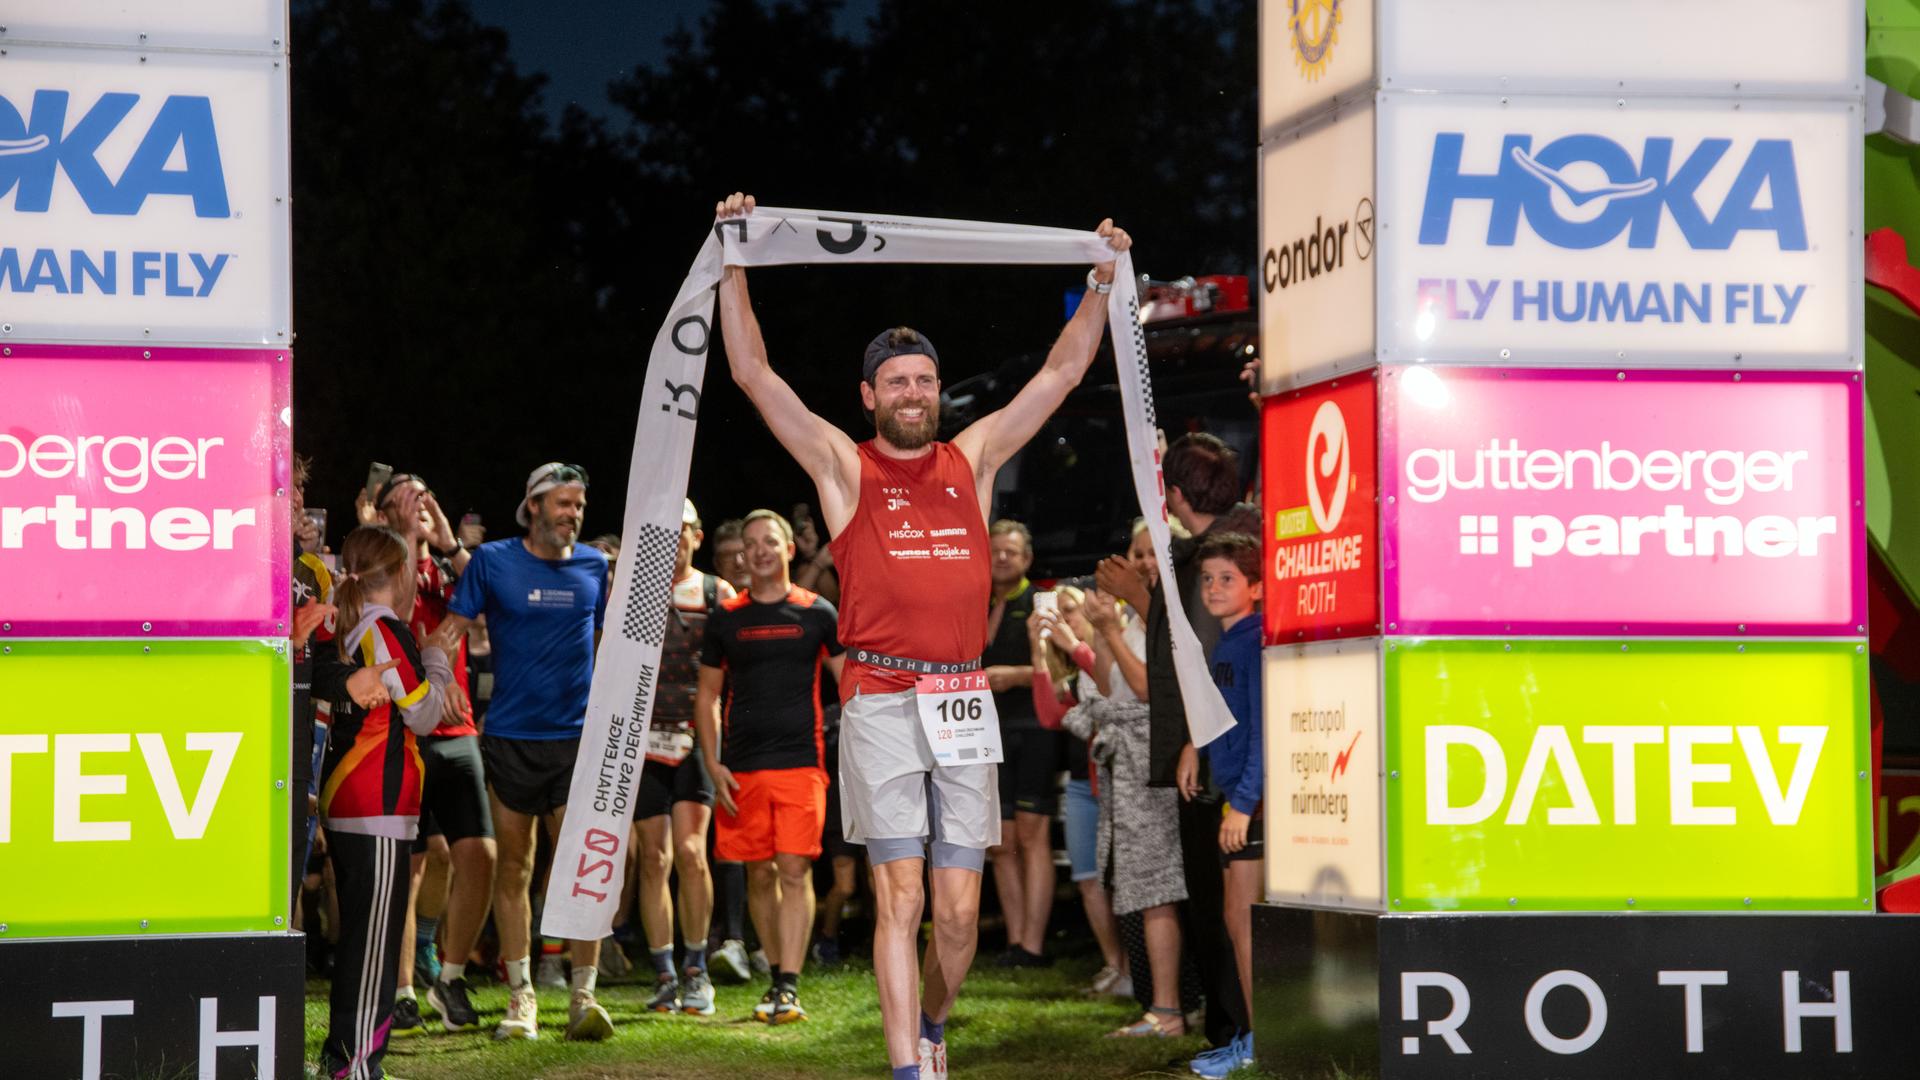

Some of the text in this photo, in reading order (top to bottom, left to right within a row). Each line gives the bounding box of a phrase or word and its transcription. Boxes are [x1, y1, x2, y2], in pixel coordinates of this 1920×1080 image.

[1418, 132, 1809, 251] HOKA
[132, 251, 229, 297] FLY
[1263, 216, 1348, 294] condor
[1417, 278, 1806, 325] FLY HUMAN FLY
[1405, 438, 1808, 505] guttenberger
[889, 530, 925, 538] HISCOX
[1513, 505, 1837, 567] partner
[1275, 535, 1362, 580] CHALLENGE
[1297, 581, 1336, 616] ROTH
[872, 654, 915, 670] ROTH
[936, 675, 986, 691] ROTH
[937, 697, 982, 722] 106
[1291, 702, 1345, 738] metropol
[1291, 745, 1328, 780] region
[1425, 725, 1829, 826] DATEV
[1291, 785, 1348, 823] nürnberg
[1401, 969, 1853, 1055] ROTH
